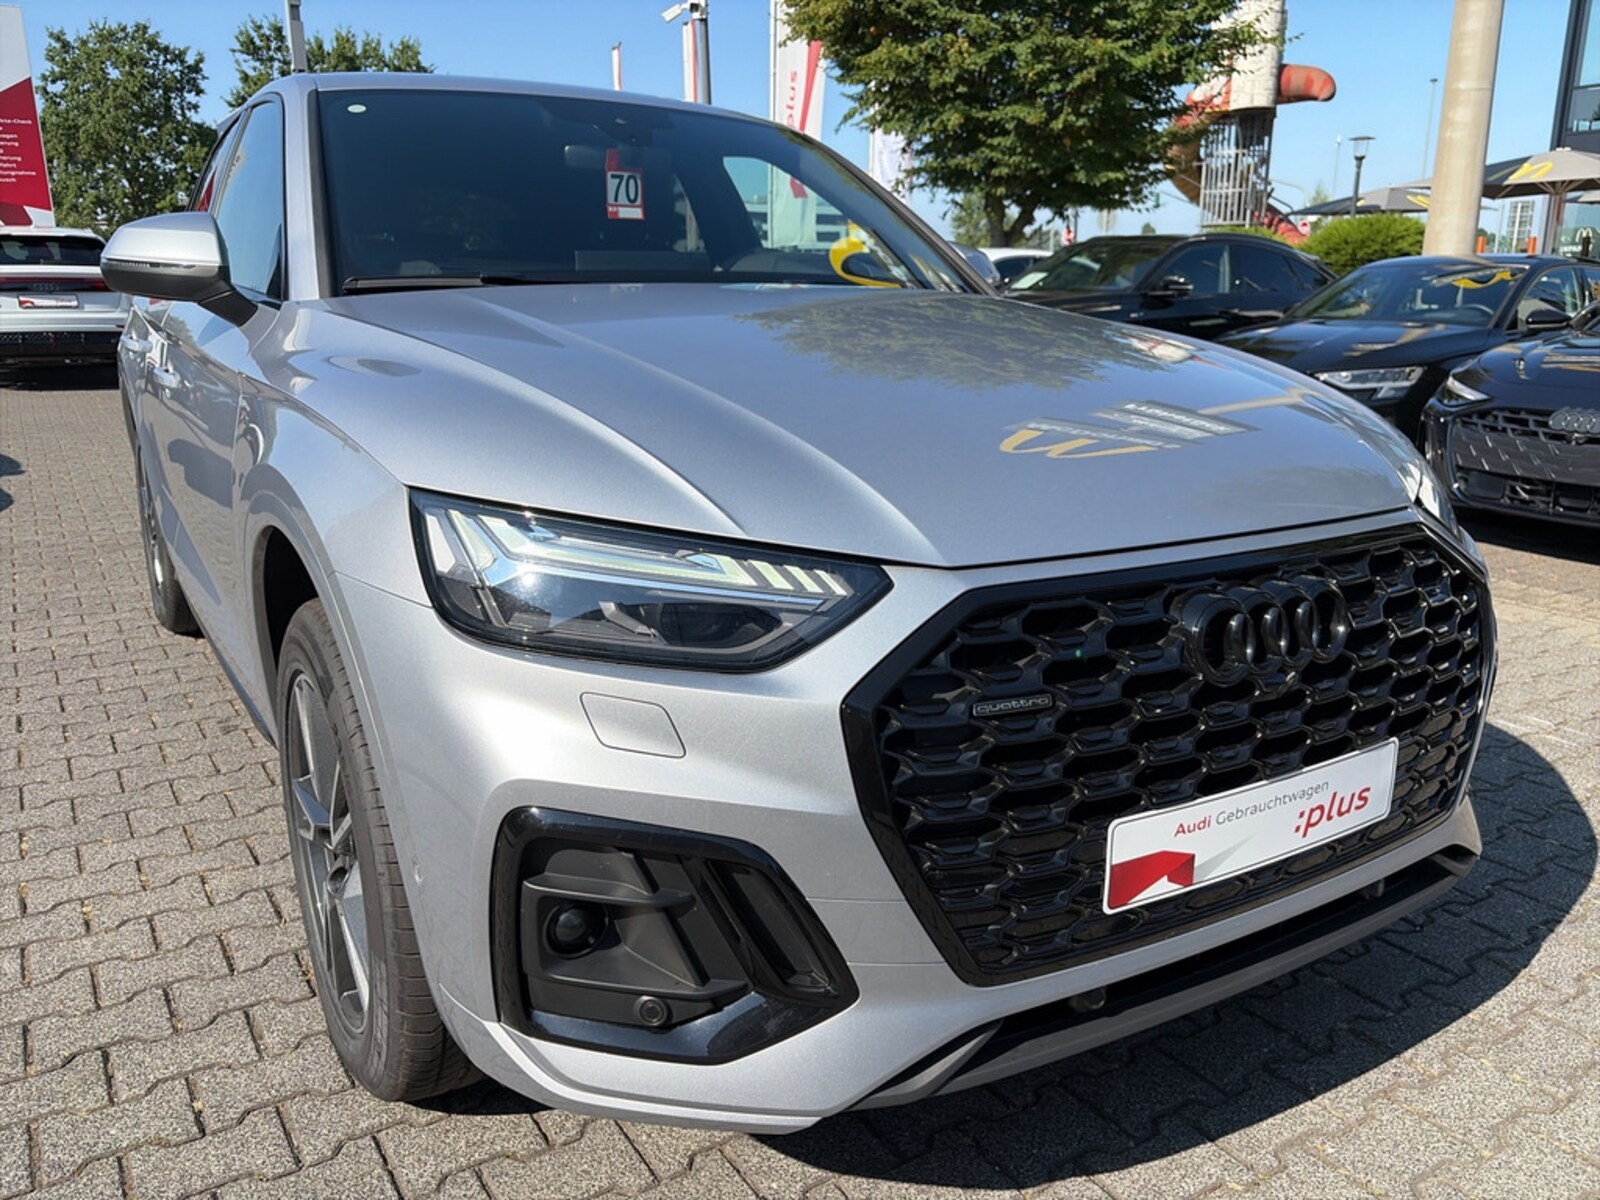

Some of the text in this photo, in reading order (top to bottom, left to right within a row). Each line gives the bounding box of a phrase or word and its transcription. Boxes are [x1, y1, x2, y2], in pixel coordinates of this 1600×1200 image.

[610, 173, 639, 204] 70
[977, 697, 1049, 713] quattro
[1174, 780, 1330, 838] Audi Gebrauchtwagen
[1294, 787, 1372, 838] :plus
